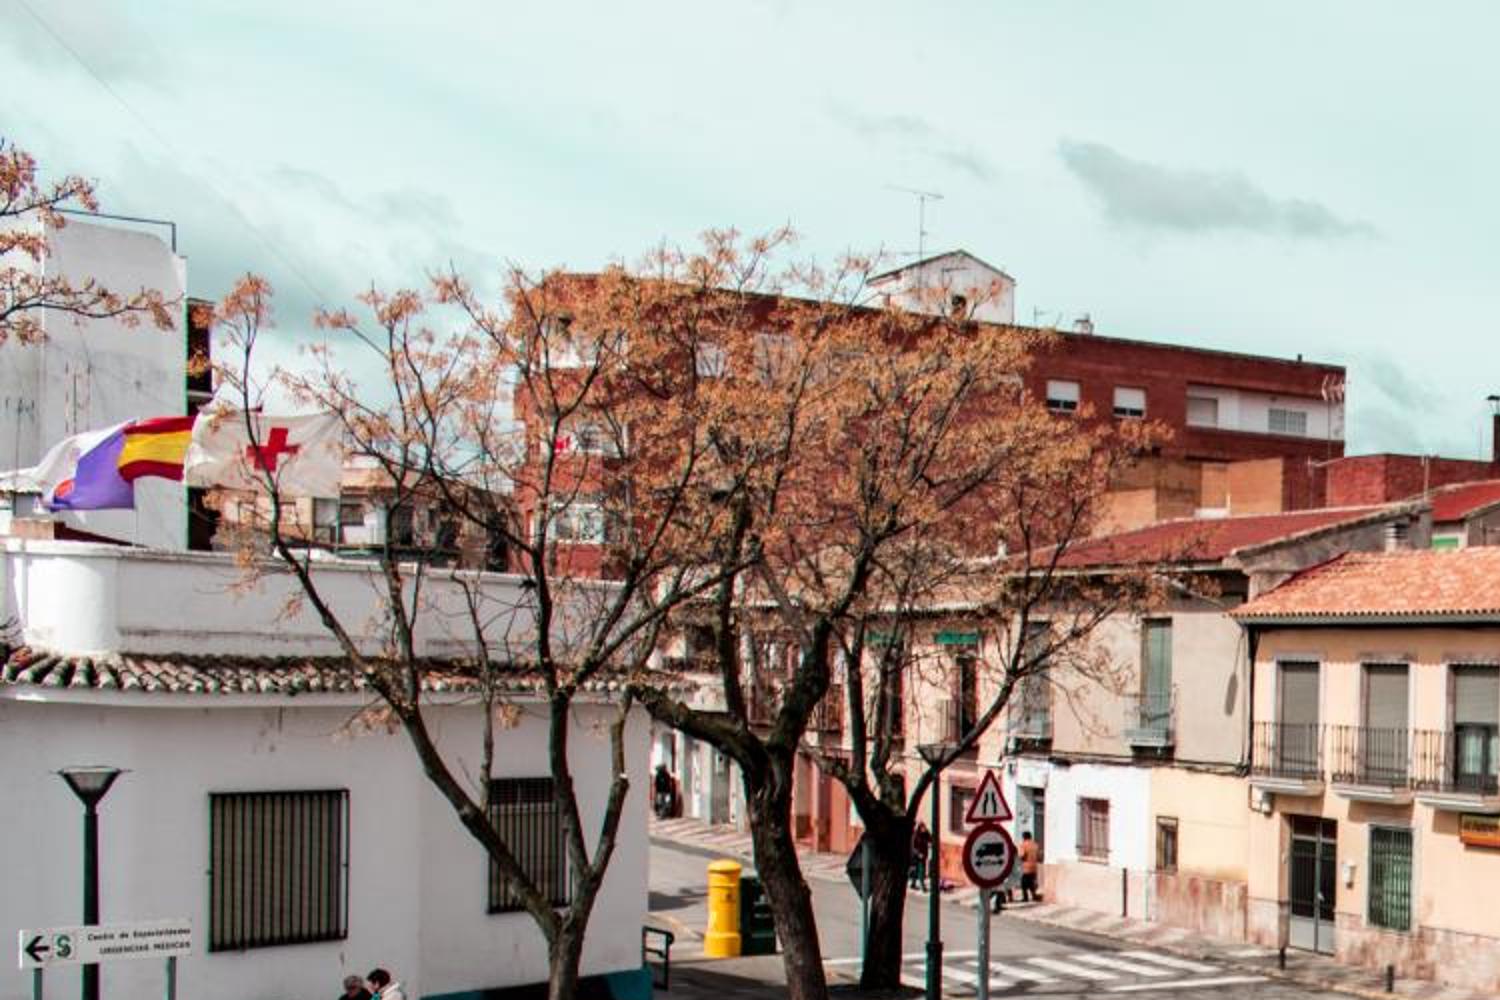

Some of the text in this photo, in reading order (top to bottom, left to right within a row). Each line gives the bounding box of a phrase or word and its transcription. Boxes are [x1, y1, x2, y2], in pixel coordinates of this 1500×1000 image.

[87, 932, 115, 942] Centro
[119, 931, 129, 940] de
[99, 943, 149, 955] URGENCIAS
